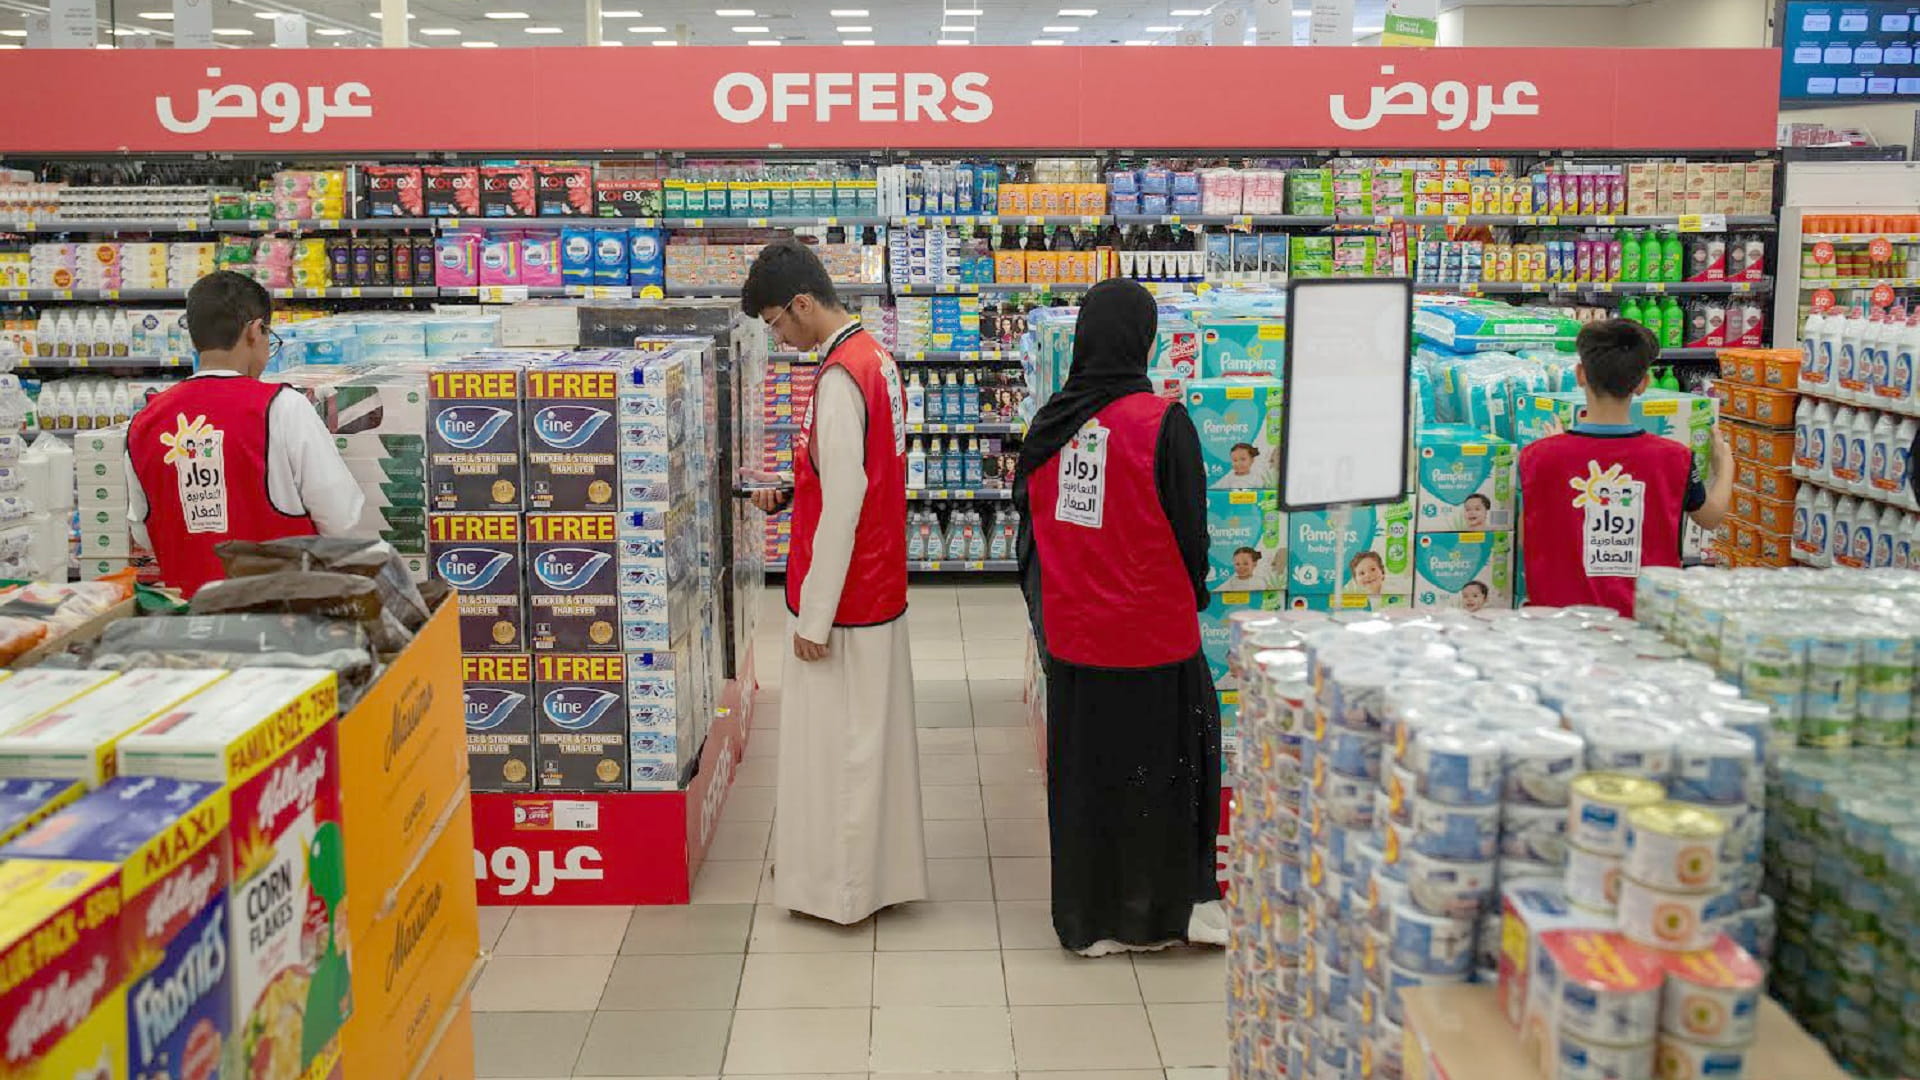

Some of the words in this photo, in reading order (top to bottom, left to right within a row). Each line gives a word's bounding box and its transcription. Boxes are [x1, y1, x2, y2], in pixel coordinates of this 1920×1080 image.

[155, 67, 373, 133] عروض
[713, 72, 994, 123] OFFERS
[1329, 65, 1540, 131] عروض
[1220, 352, 1277, 373] Pampers
[1203, 420, 1248, 434] Pampers
[435, 455, 467, 463] THICKER
[476, 455, 516, 463] STRONGER
[531, 455, 563, 463] THICKER
[573, 455, 614, 463] STRONGER
[454, 464, 474, 473] THAN
[475, 464, 497, 473] EVER
[552, 464, 572, 473] THAN
[574, 464, 594, 473] EVER
[1432, 468, 1473, 482] Pampers
[1591, 509, 1635, 535] رواد
[1207, 525, 1250, 539] Pampers
[1300, 523, 1357, 543] Pamprs
[1590, 536, 1634, 547] التعاونية
[1430, 557, 1472, 570] Pampers
[1590, 549, 1633, 564] الصغار
[476, 595, 517, 604] STRONGER
[532, 595, 564, 604] THICKER
[573, 595, 615, 604] STRONGER
[478, 606, 498, 615] EVER
[553, 606, 573, 615] THAN
[575, 606, 595, 615] EVER
[462, 657, 527, 681] FREE
[464, 694, 489, 714] ine
[552, 693, 582, 714] Fine
[487, 735, 529, 744] STRONGER
[540, 735, 573, 744] THICKER
[581, 735, 623, 744] STRONGER
[231, 727, 275, 776] FAMILY
[468, 744, 487, 753] THAN
[489, 744, 509, 753] EVER
[560, 744, 580, 753] THAN
[583, 744, 603, 753] EVER
[144, 807, 216, 875] MAXI
[246, 859, 292, 921] CORN
[249, 896, 294, 953] FLAKES
